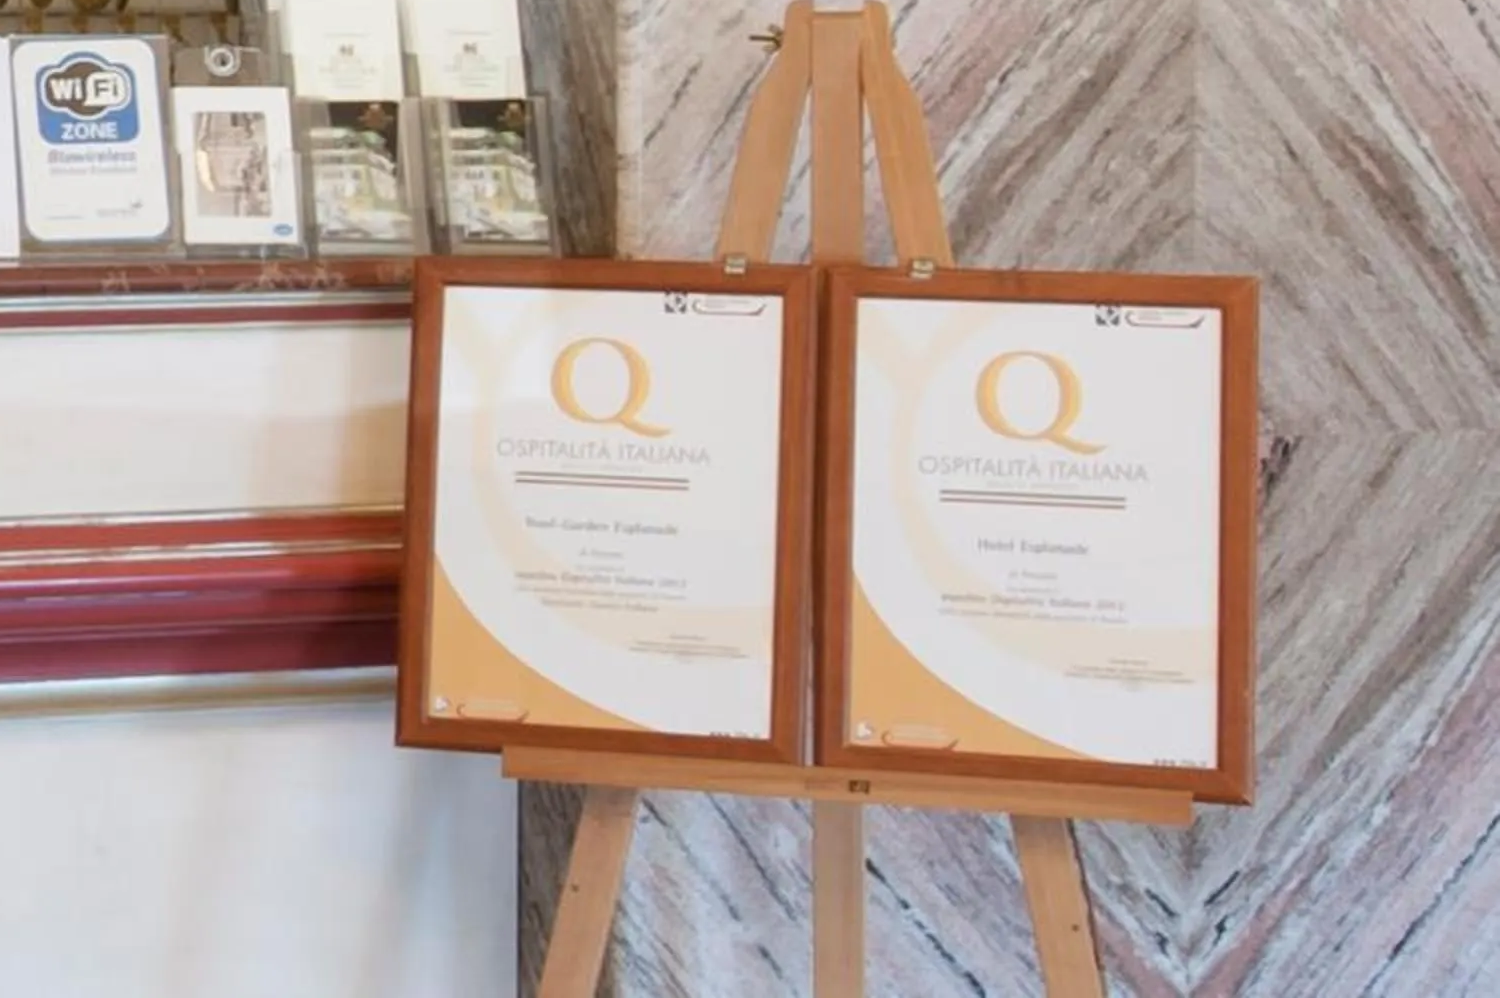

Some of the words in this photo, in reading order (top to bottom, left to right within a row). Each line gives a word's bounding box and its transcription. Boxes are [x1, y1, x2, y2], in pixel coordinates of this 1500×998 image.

[60, 121, 118, 140] ZONE
[550, 336, 671, 438] Q
[974, 349, 1108, 456] Q
[496, 437, 610, 461] OSPITALITÀ
[618, 442, 711, 465] ITALIANA
[917, 454, 1041, 479] OSPITALITÀ
[1049, 460, 1149, 482] ITALIANA
